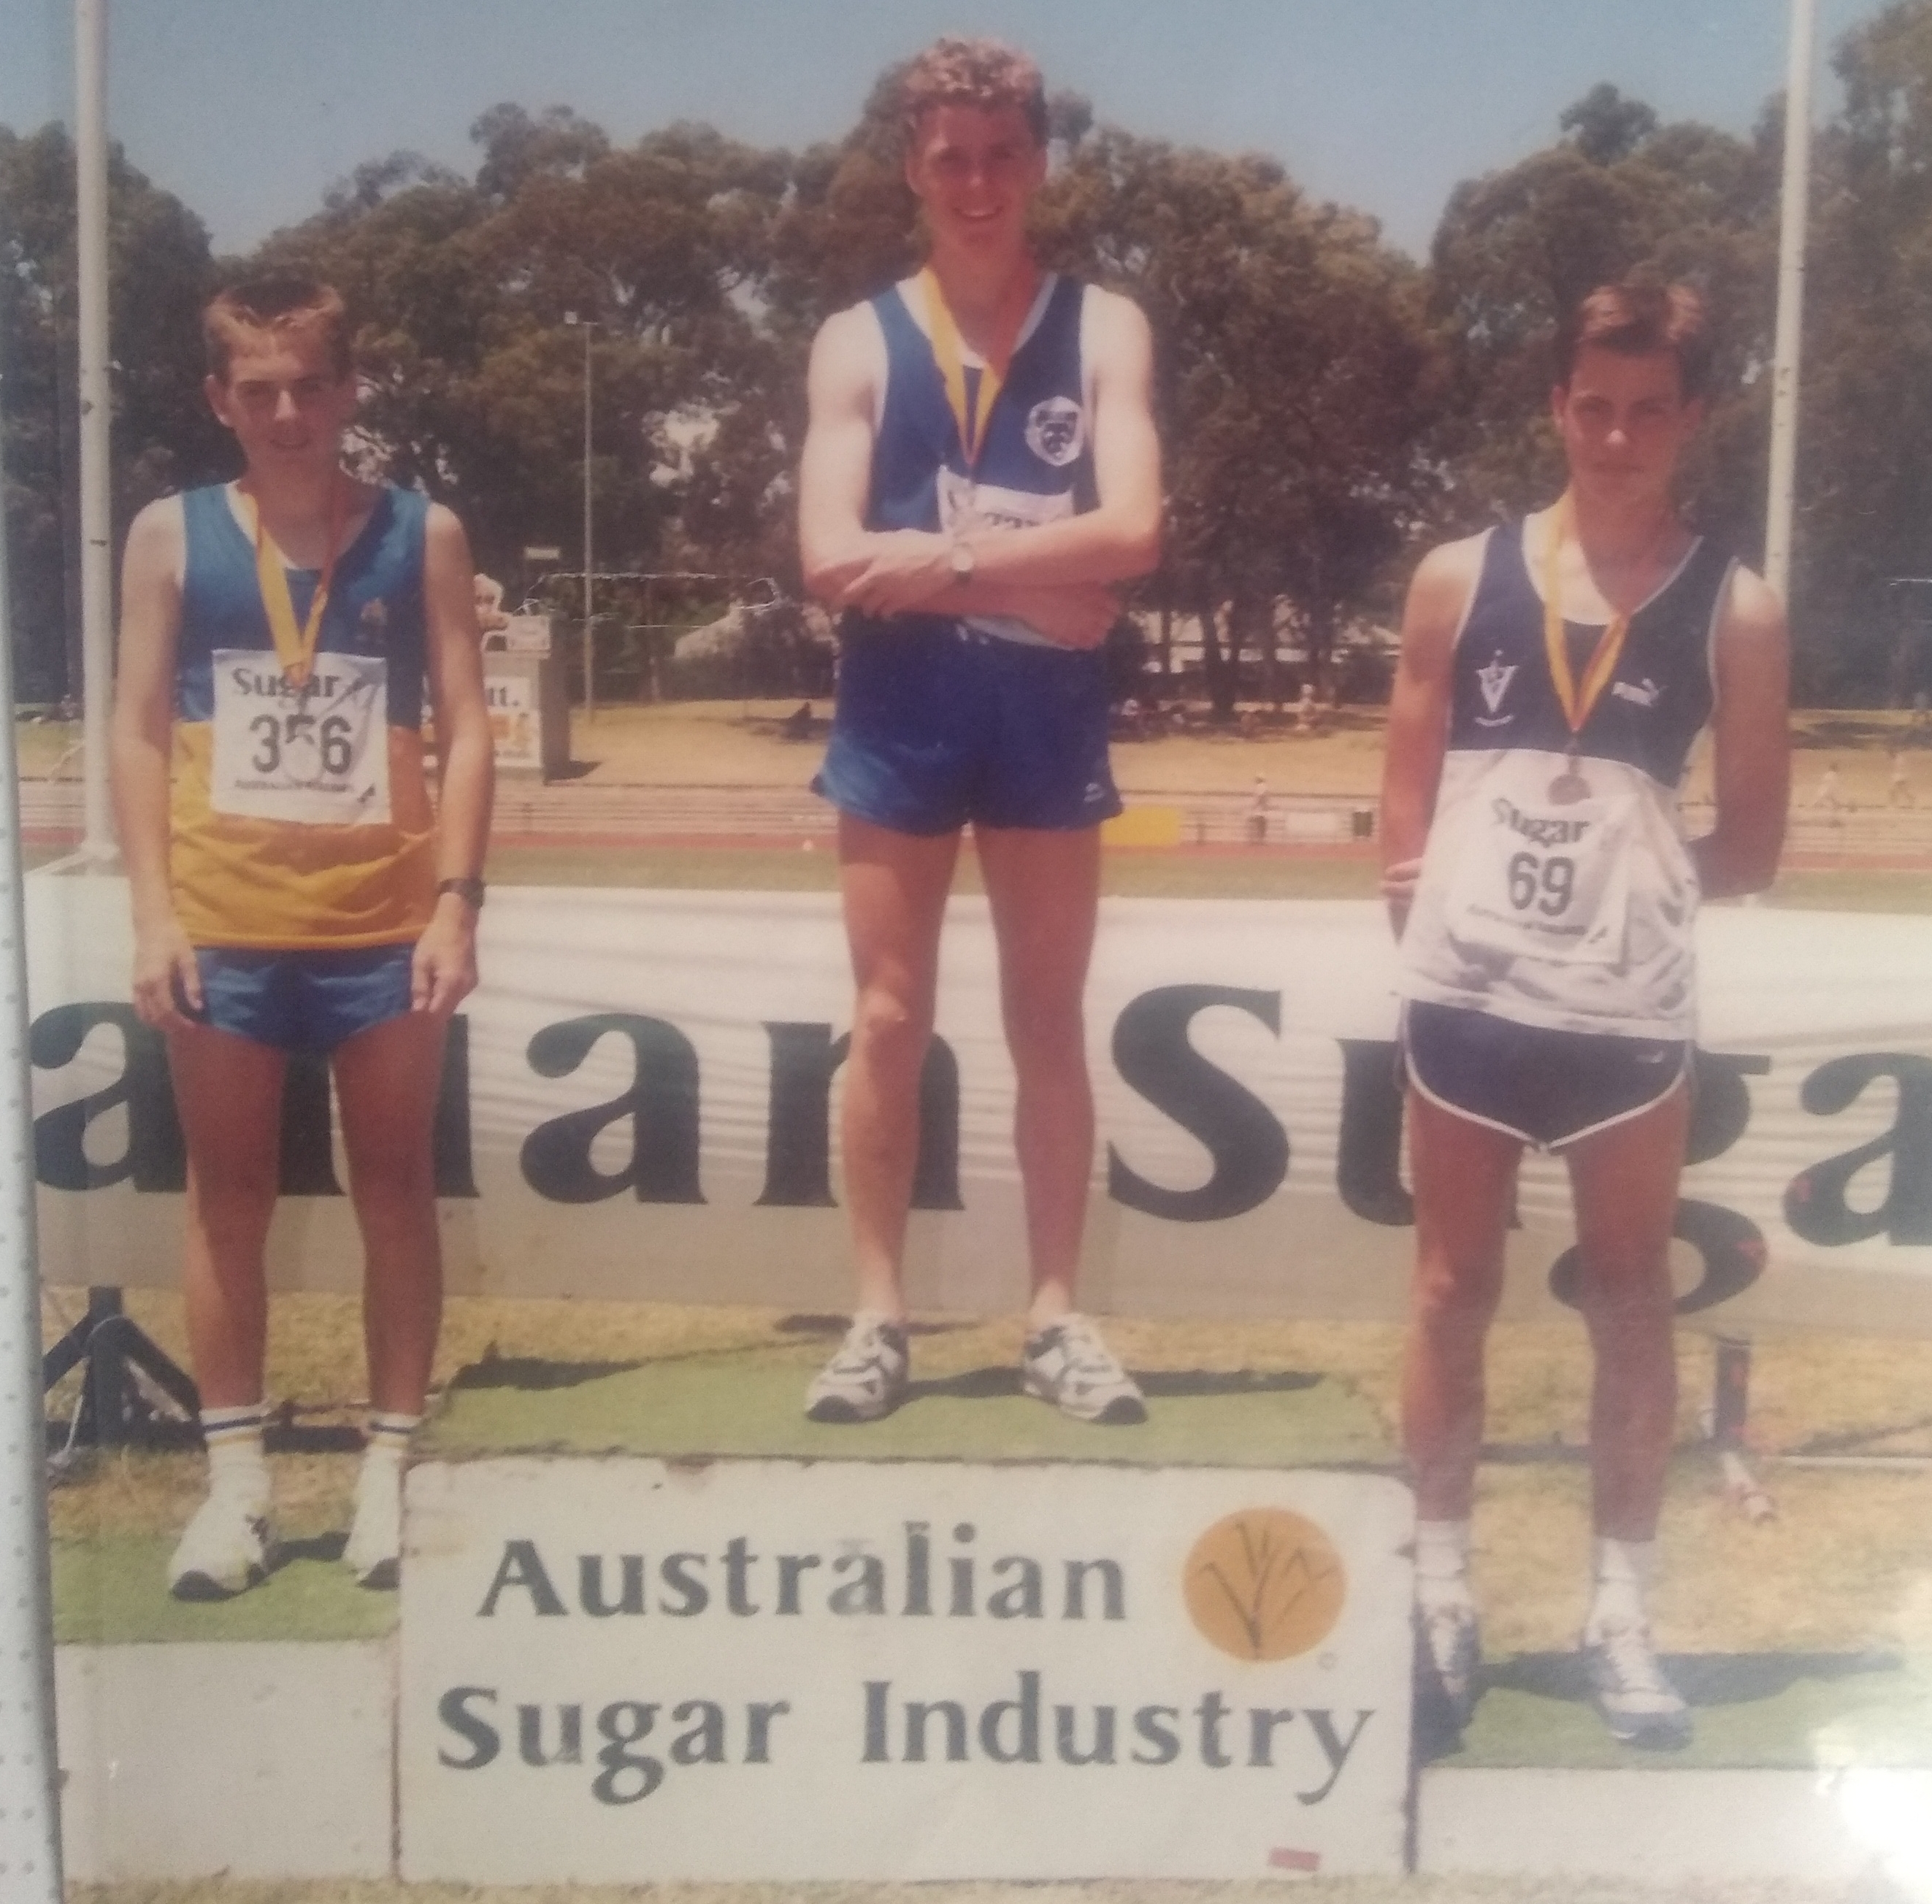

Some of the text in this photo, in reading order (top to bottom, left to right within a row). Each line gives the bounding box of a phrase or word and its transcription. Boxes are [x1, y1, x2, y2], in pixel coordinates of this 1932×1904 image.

[1491, 797, 1590, 848] Sugar
[1508, 851, 1576, 917] 69
[476, 1521, 1128, 1621] Australian
[437, 1670, 1376, 1808] Sugar Industry
